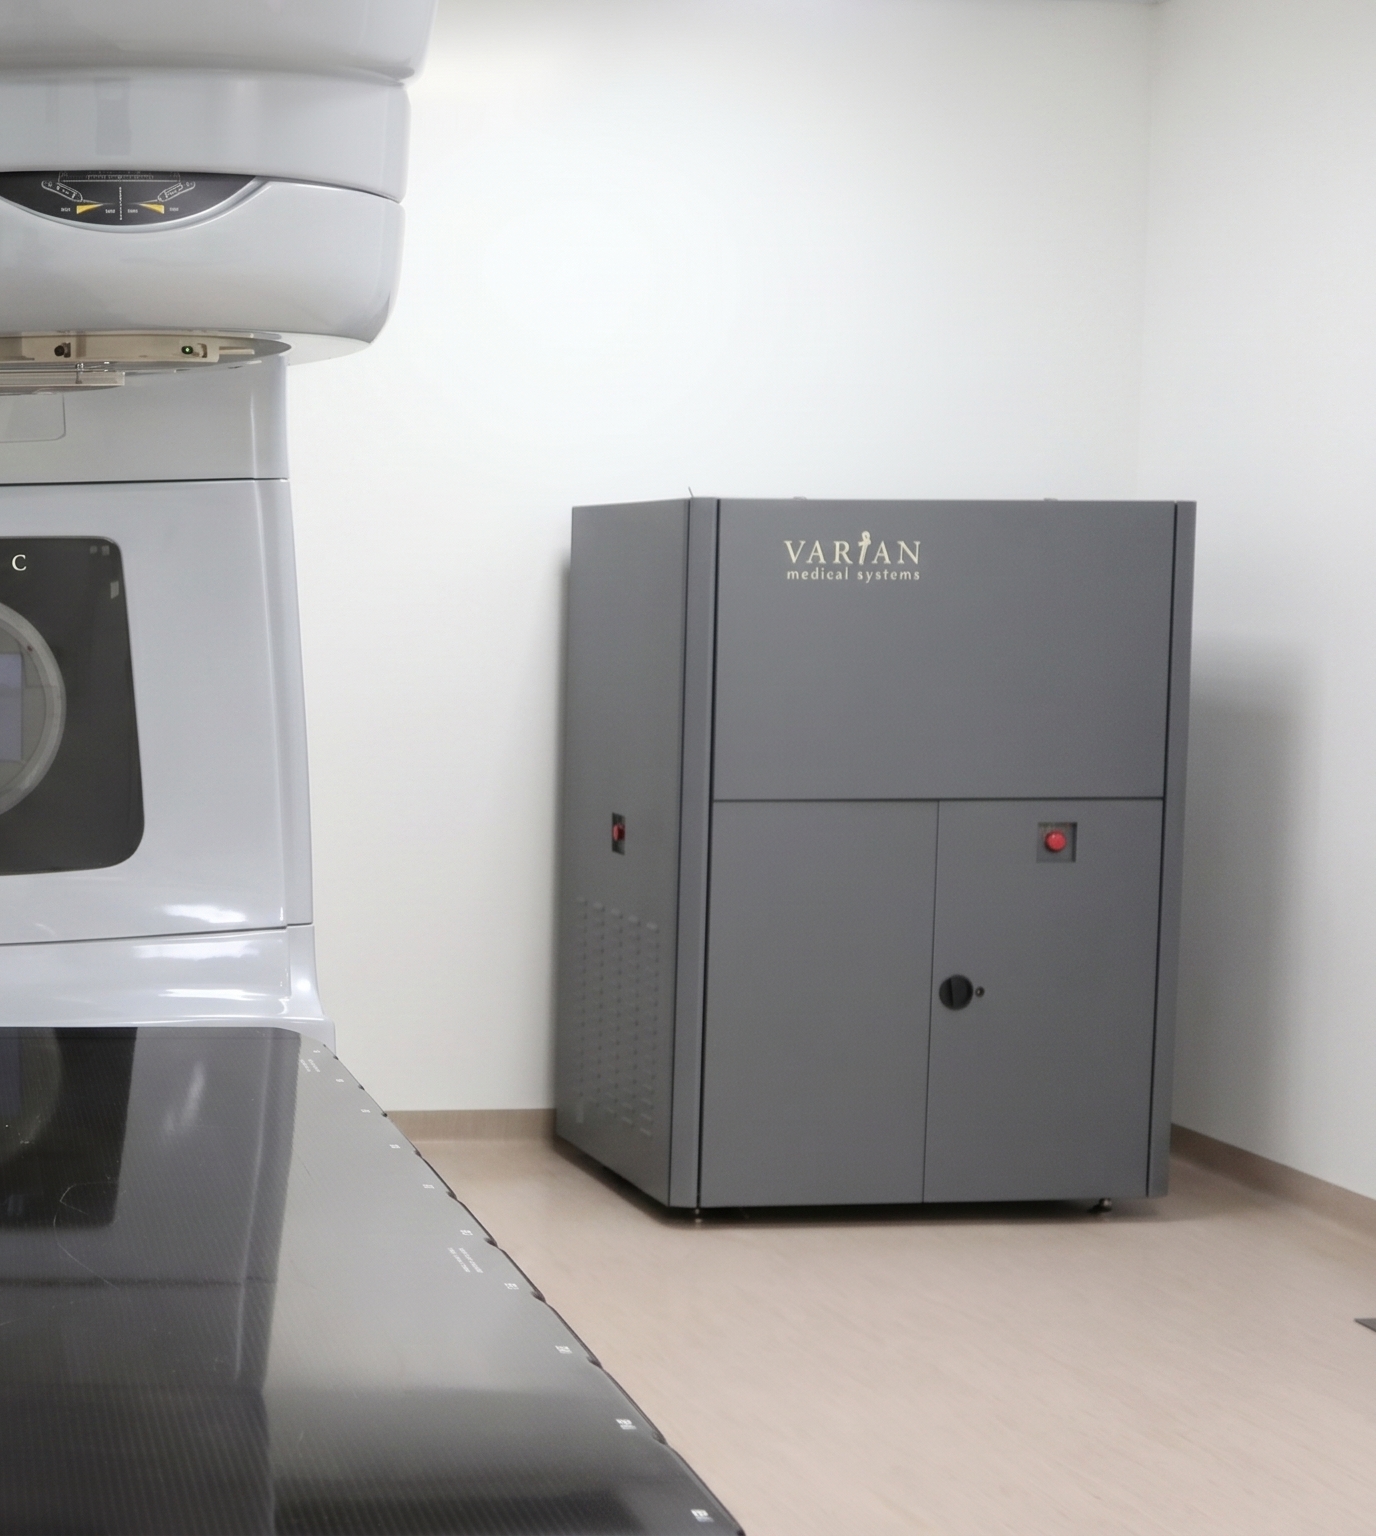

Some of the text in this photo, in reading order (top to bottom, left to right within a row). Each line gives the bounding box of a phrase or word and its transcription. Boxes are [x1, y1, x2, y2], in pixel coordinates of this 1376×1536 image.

[783, 530, 921, 565] VARIAN
[787, 567, 920, 584] medical systems
